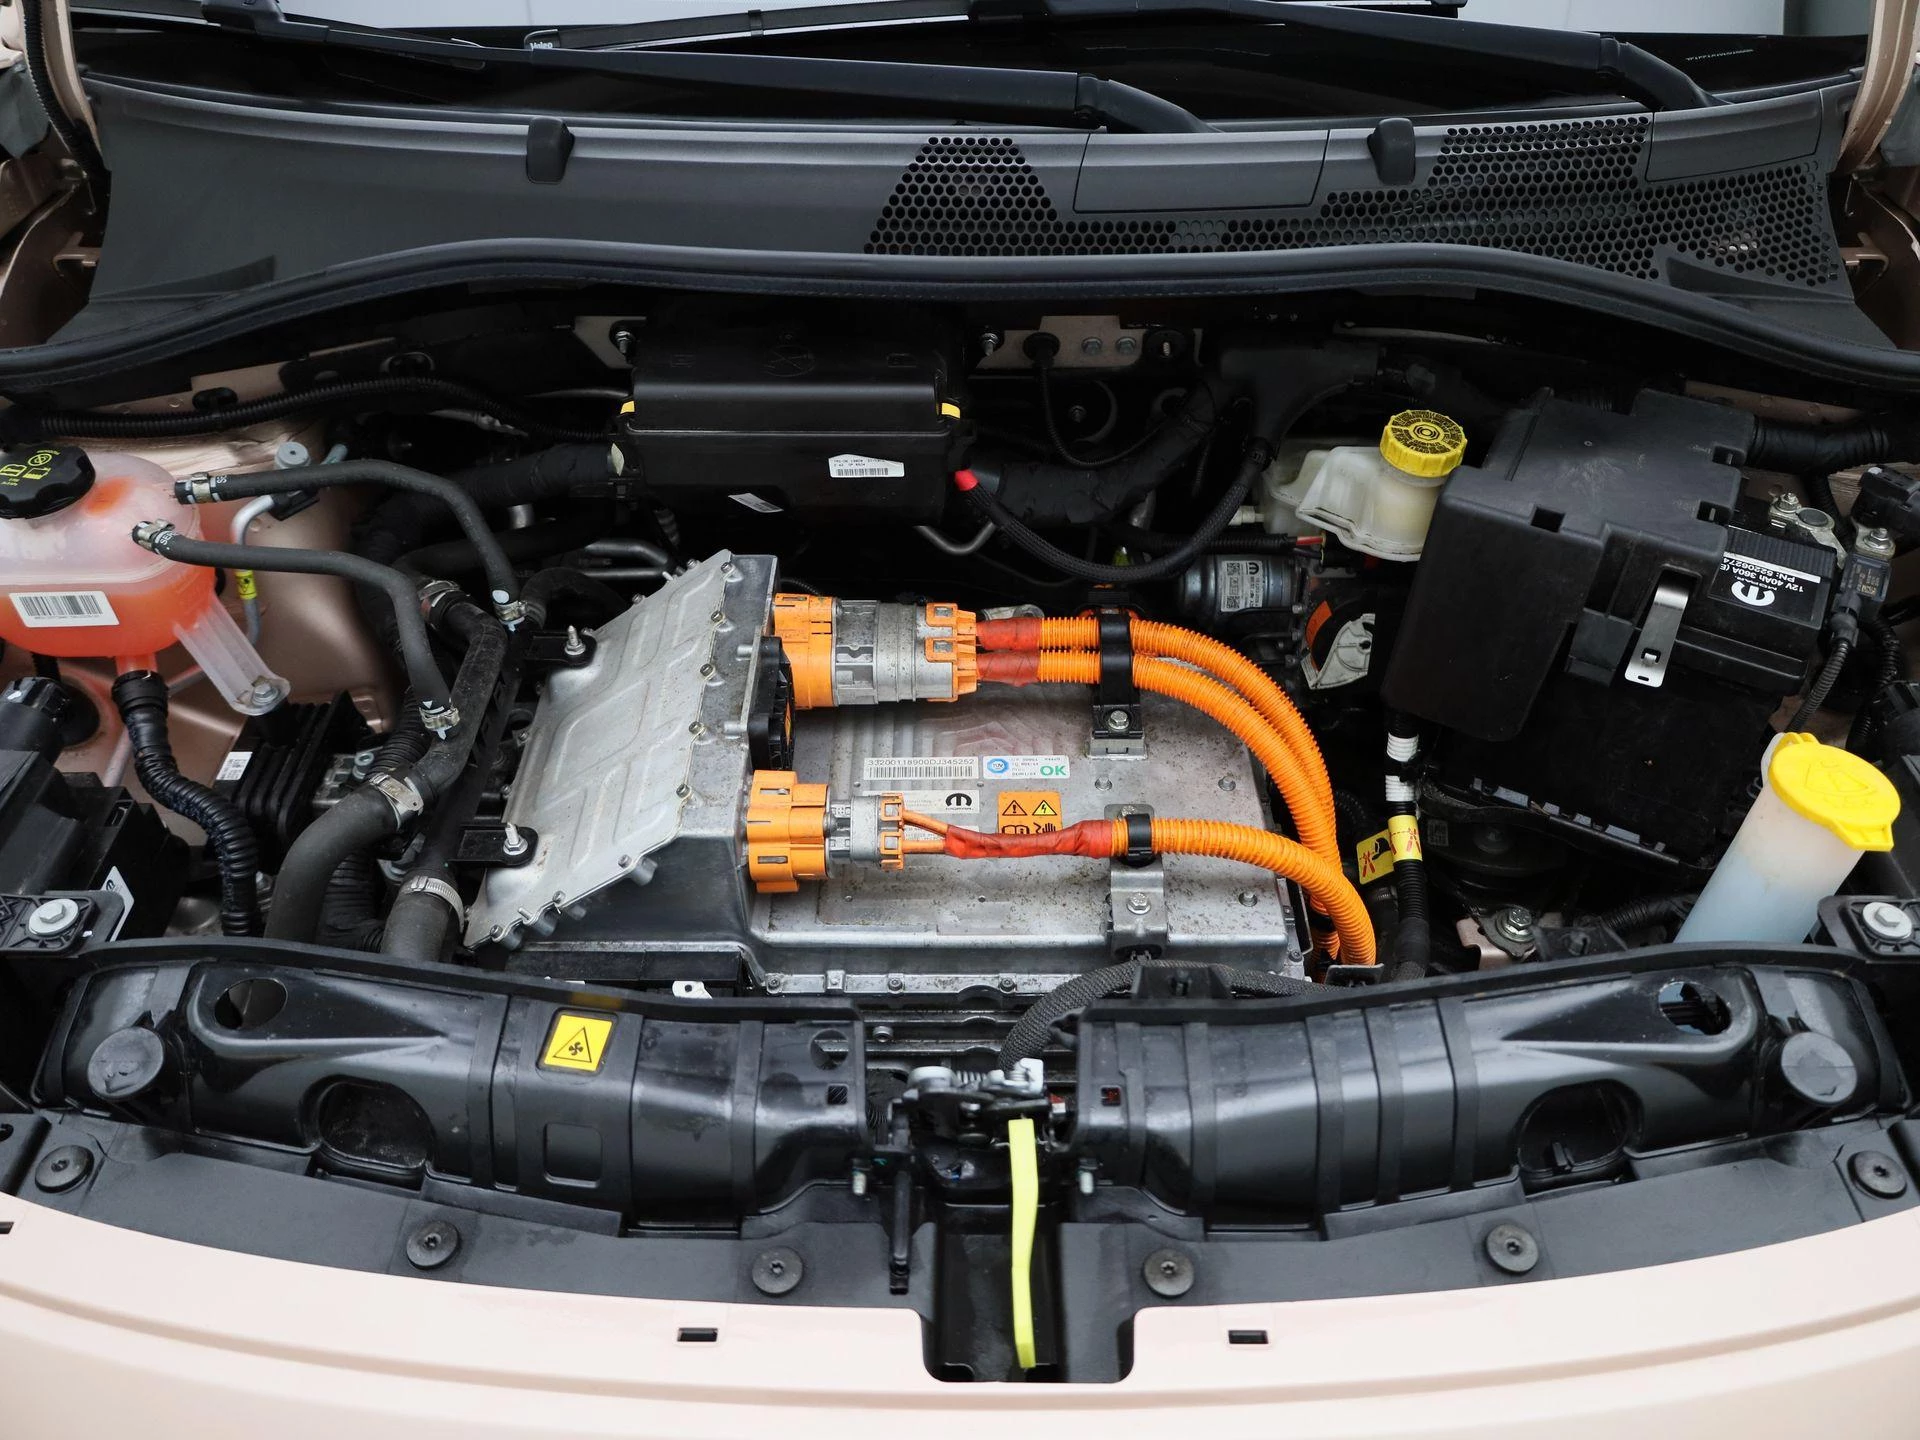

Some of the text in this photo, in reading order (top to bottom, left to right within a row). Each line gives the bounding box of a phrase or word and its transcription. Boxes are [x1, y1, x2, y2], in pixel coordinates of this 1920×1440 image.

[1723, 557, 1796, 583] PN: 52206274
[1732, 568, 1757, 579] 360A
[1758, 575, 1784, 586] 40Ah
[1785, 583, 1804, 593] 12V
[1040, 765, 1067, 776] OK
